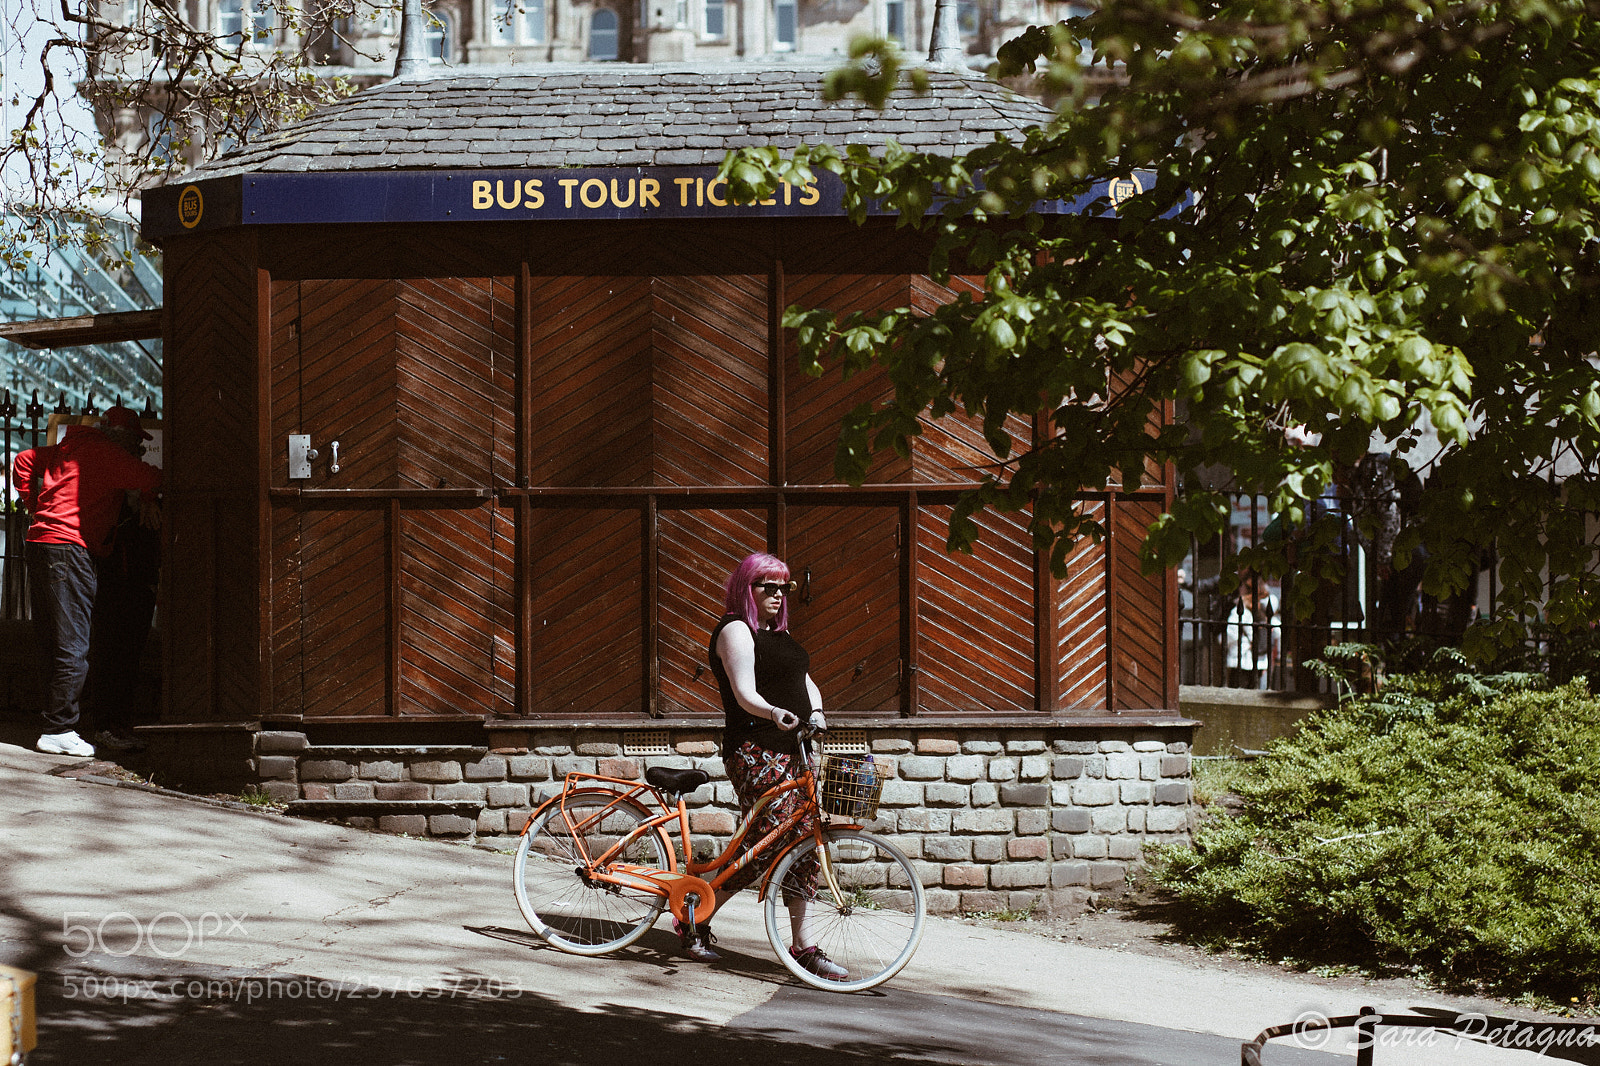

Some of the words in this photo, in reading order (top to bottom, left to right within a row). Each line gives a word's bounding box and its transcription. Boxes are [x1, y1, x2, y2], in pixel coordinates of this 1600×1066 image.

[472, 179, 545, 210] BUS
[558, 178, 661, 209] TOUR
[673, 176, 821, 207] TICTS
[1116, 186, 1135, 198] BUS
[184, 200, 197, 211] BUS
